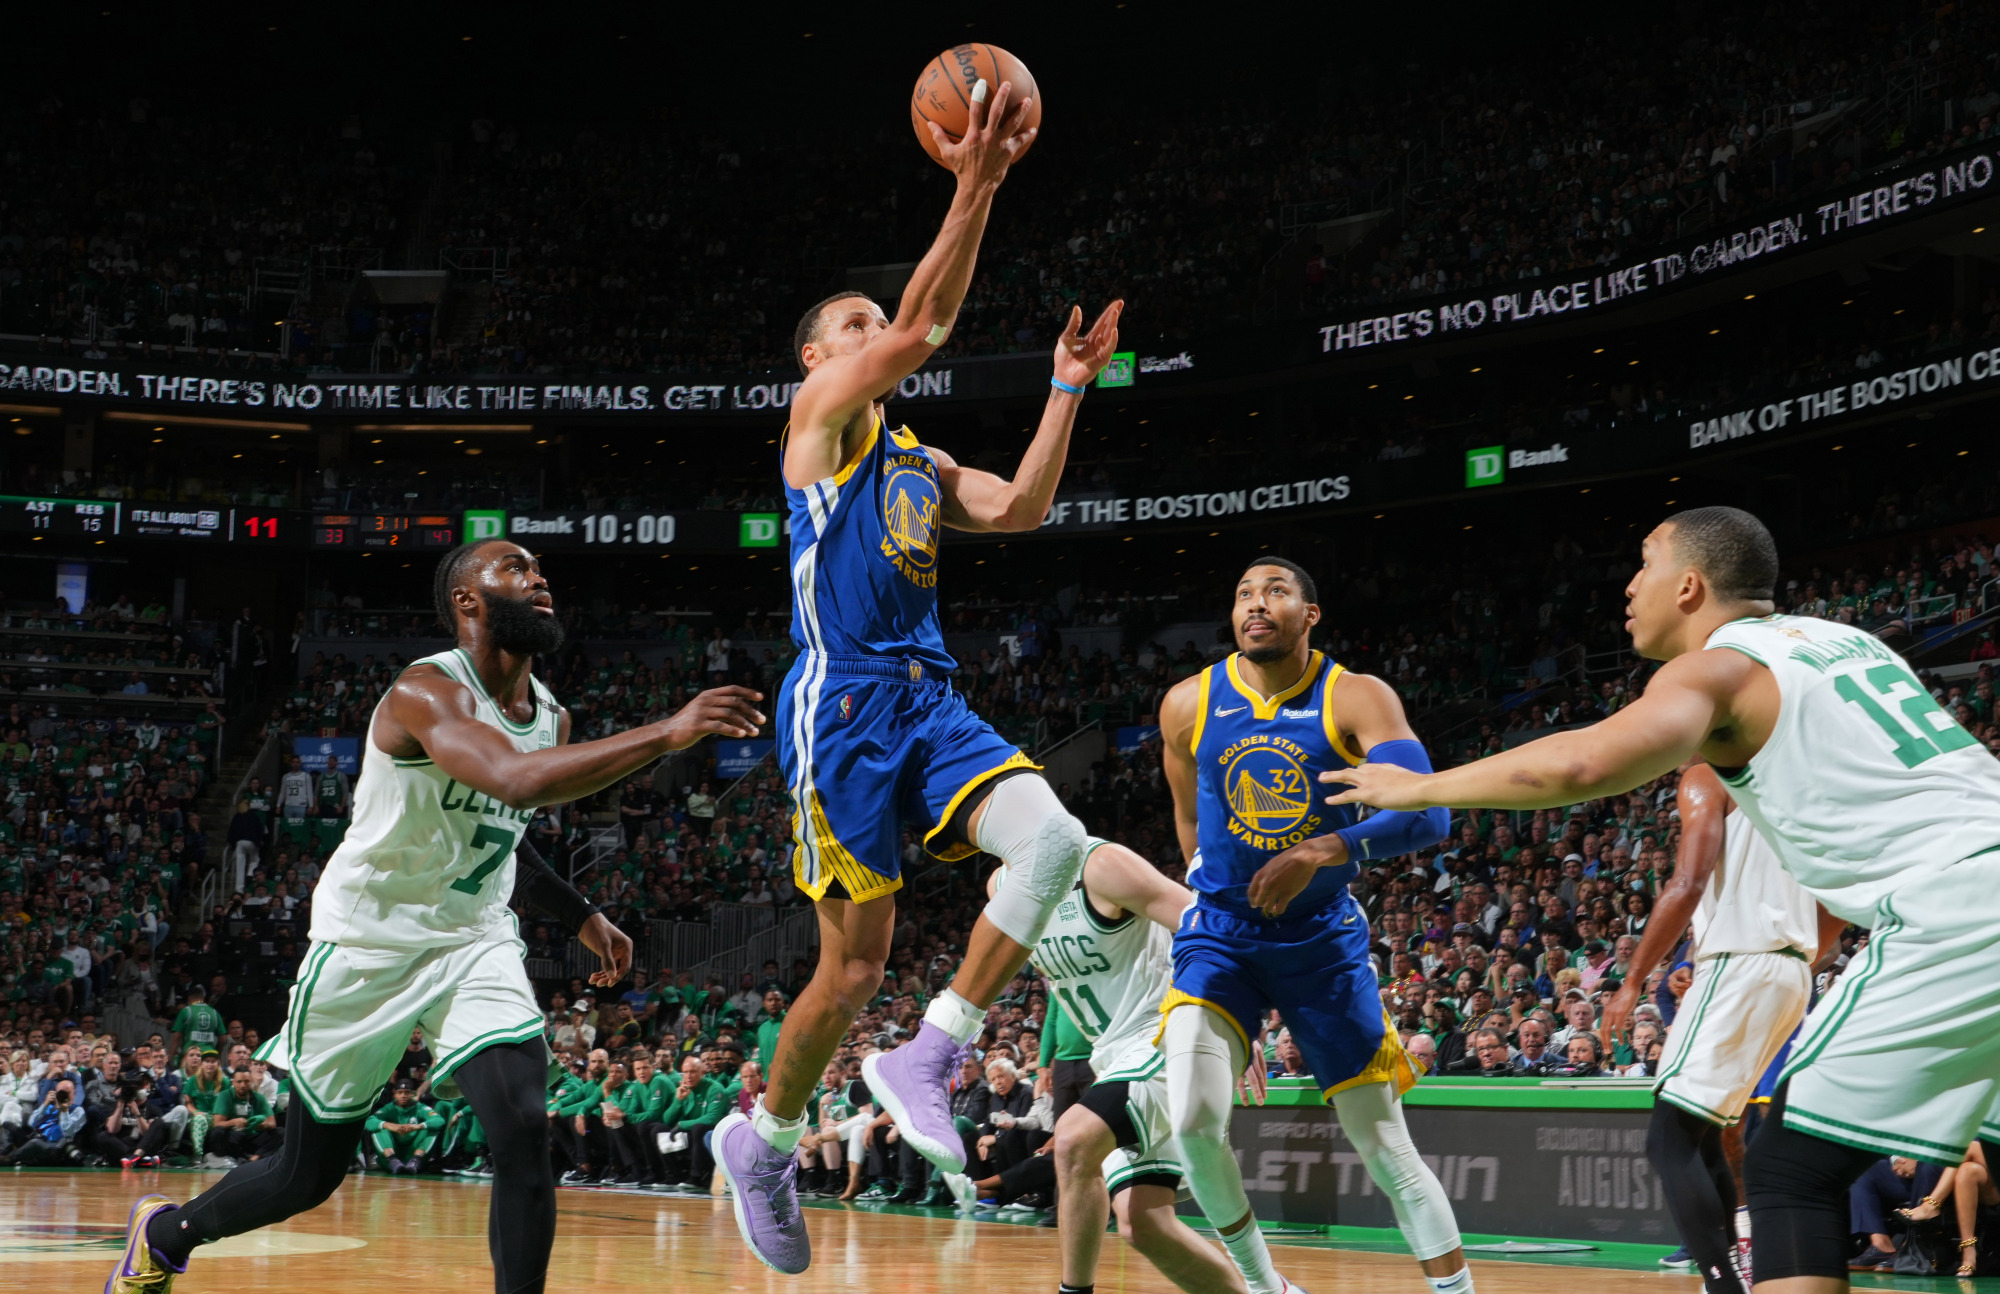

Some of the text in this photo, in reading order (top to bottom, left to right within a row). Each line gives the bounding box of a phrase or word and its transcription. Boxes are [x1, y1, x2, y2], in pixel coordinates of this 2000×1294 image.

[1319, 307, 1434, 352] THERE'S
[1440, 299, 1488, 331] NO
[1491, 280, 1590, 323] PLACE
[1594, 262, 1649, 305] LIKE
[1816, 171, 1937, 236] THERE'S
[1942, 154, 1993, 199] NO
[136, 374, 266, 407] THERE'S
[273, 382, 321, 408] NO
[326, 386, 401, 409] TIME
[407, 386, 470, 409] LIKE
[480, 386, 535, 410] THE
[542, 385, 655, 410] FINALS.
[664, 386, 726, 410] GET
[898, 369, 952, 398] ON!
[1690, 409, 1755, 449] BANK
[1758, 400, 1794, 431] OF
[1797, 386, 1847, 422] THE
[1851, 357, 1962, 411] BOSTON
[883, 455, 923, 476] GOLDEN
[1508, 443, 1569, 468] Bank
[24, 501, 105, 516] AST REB
[920, 495, 938, 531] 30
[1077, 499, 1130, 523] THE
[1135, 489, 1245, 521] BOSTON
[1250, 475, 1350, 511] CELTICS
[32, 514, 102, 532] 11 15
[244, 516, 278, 538] 11
[325, 528, 344, 544] 33
[466, 514, 676, 544] TD Bank 10:00
[741, 518, 776, 541] TD
[1788, 635, 1893, 674] WILLIAMS
[1282, 708, 1319, 719] Rakuten
[1834, 663, 1981, 769] 12
[1218, 735, 1310, 765] GOLDEN STATE
[1268, 769, 1302, 793] 32
[1227, 814, 1322, 851] WARRIORS
[449, 823, 516, 895] 7
[1059, 984, 1112, 1036] 11
